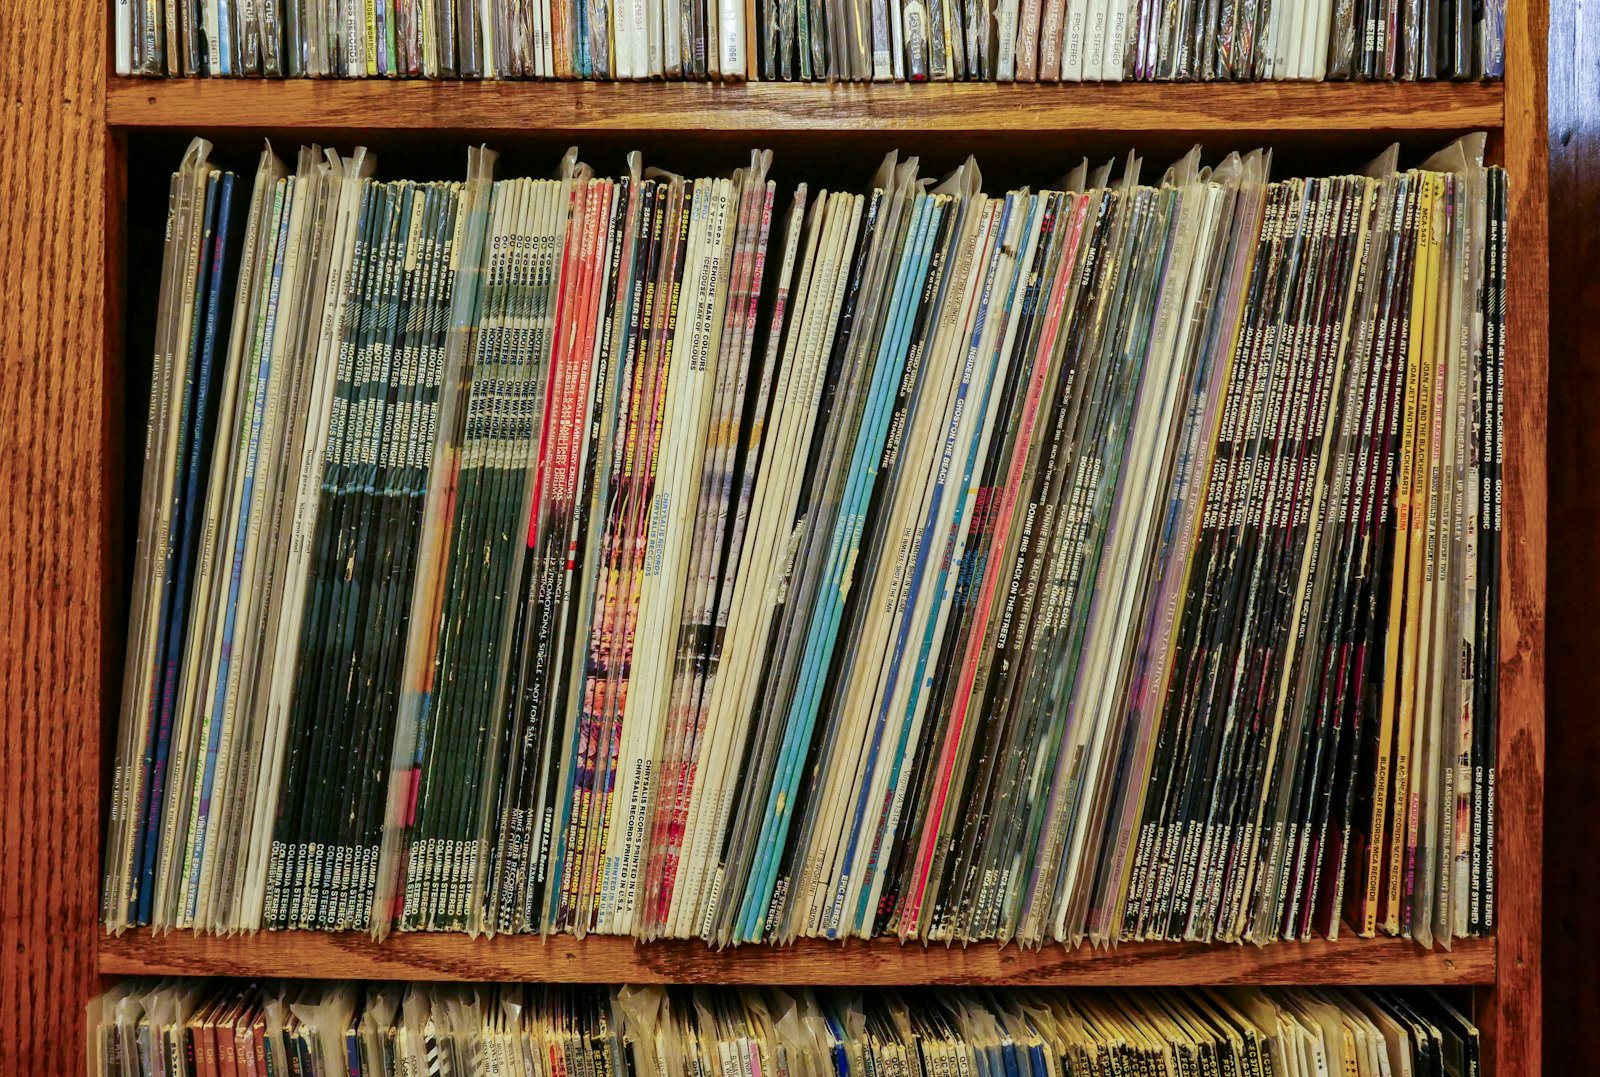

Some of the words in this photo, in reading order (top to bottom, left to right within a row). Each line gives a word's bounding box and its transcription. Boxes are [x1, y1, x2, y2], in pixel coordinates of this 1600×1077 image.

[1072, 12, 1080, 31] EPIC
[1115, 12, 1123, 31] EPIC
[1069, 33, 1078, 65] STEREO
[1112, 33, 1122, 64] STEREO
[1419, 208, 1428, 247] MCA-5437
[269, 276, 279, 303] HOLLY
[707, 257, 719, 297] ICEHOUSE
[265, 304, 275, 326] BETH
[704, 303, 713, 320] MAN
[602, 317, 612, 349] HUNTERS
[702, 322, 710, 333] OF
[1330, 320, 1340, 340] JOAN
[1486, 321, 1494, 343] JOAN
[260, 327, 272, 361] VINCENT
[509, 328, 520, 365] HOOTERS
[697, 334, 709, 371] COLOURS
[1328, 341, 1336, 356] JETT
[1485, 345, 1494, 363] JETT
[151, 354, 160, 380] HEAVEN
[390, 348, 402, 387] HOOTERS
[433, 347, 445, 385] HOOTERS
[961, 346, 977, 384] INSIDERS
[1325, 357, 1334, 373] AND
[1409, 363, 1417, 384] JOAN
[1485, 365, 1493, 383] AND
[254, 377, 265, 403] HOLLY
[504, 380, 513, 397] ONE
[595, 358, 607, 403] COLLECTORS
[1322, 374, 1331, 388] THE
[1485, 385, 1493, 401] THE
[148, 381, 158, 420] SEVENTEEN
[501, 398, 510, 415] WAY
[630, 392, 641, 421] SONGS
[1407, 386, 1415, 403] JETT
[252, 405, 261, 424] AND
[382, 403, 394, 442] NERVOUS
[426, 401, 437, 441] NERVOUS
[1314, 389, 1328, 436] BLACKHEARTS
[1406, 405, 1414, 422] AND
[249, 424, 258, 439] THE
[498, 416, 508, 440] HOME
[628, 423, 637, 440] AND
[1483, 402, 1492, 462] BLACKHEARTS
[244, 440, 256, 477] ITALIANS
[378, 443, 388, 469] NIGHT
[422, 441, 432, 467] NIGHT
[623, 442, 634, 477] STORIES
[943, 440, 954, 456] THE
[936, 456, 950, 484] BEACH
[1307, 458, 1316, 476] LOVE
[1400, 440, 1411, 495] BLACKHEARTS
[1303, 477, 1313, 496] ROCK
[1483, 477, 1491, 501] GOOD
[649, 494, 661, 538] CHRYSALIS
[1022, 502, 1037, 535] DONNIE
[1299, 506, 1308, 523] ROLL
[1398, 503, 1406, 530] ALBUM
[1482, 503, 1490, 529] MUSIC
[1018, 536, 1029, 553] IRIS
[1012, 556, 1024, 580] BACK
[1009, 580, 1019, 594] ON
[539, 572, 555, 640] PROMOTIONAL
[884, 599, 893, 613] DARK
[1004, 594, 1015, 612] THE
[996, 611, 1011, 649] STREETS
[535, 643, 545, 674] SINGLE
[531, 684, 540, 703] NOT
[528, 705, 537, 723] FOR
[630, 758, 643, 803] CHRYSALIS
[899, 769, 911, 791] Virgin
[1376, 756, 1387, 807] BLACKHEART
[1474, 766, 1482, 782] CBS
[579, 791, 590, 826] WARNER
[625, 804, 636, 841] RECORDS
[441, 839, 453, 881] COLUMBIA
[536, 854, 547, 882] Records
[619, 843, 631, 878] PRINTED
[570, 854, 582, 893] RECORDS
[618, 879, 625, 888] IN
[837, 874, 848, 894] EPIC
[1368, 866, 1378, 901] RECORDS
[436, 882, 447, 914] STEREO
[829, 894, 843, 926] STEREO
[1470, 892, 1479, 923] STEREO
